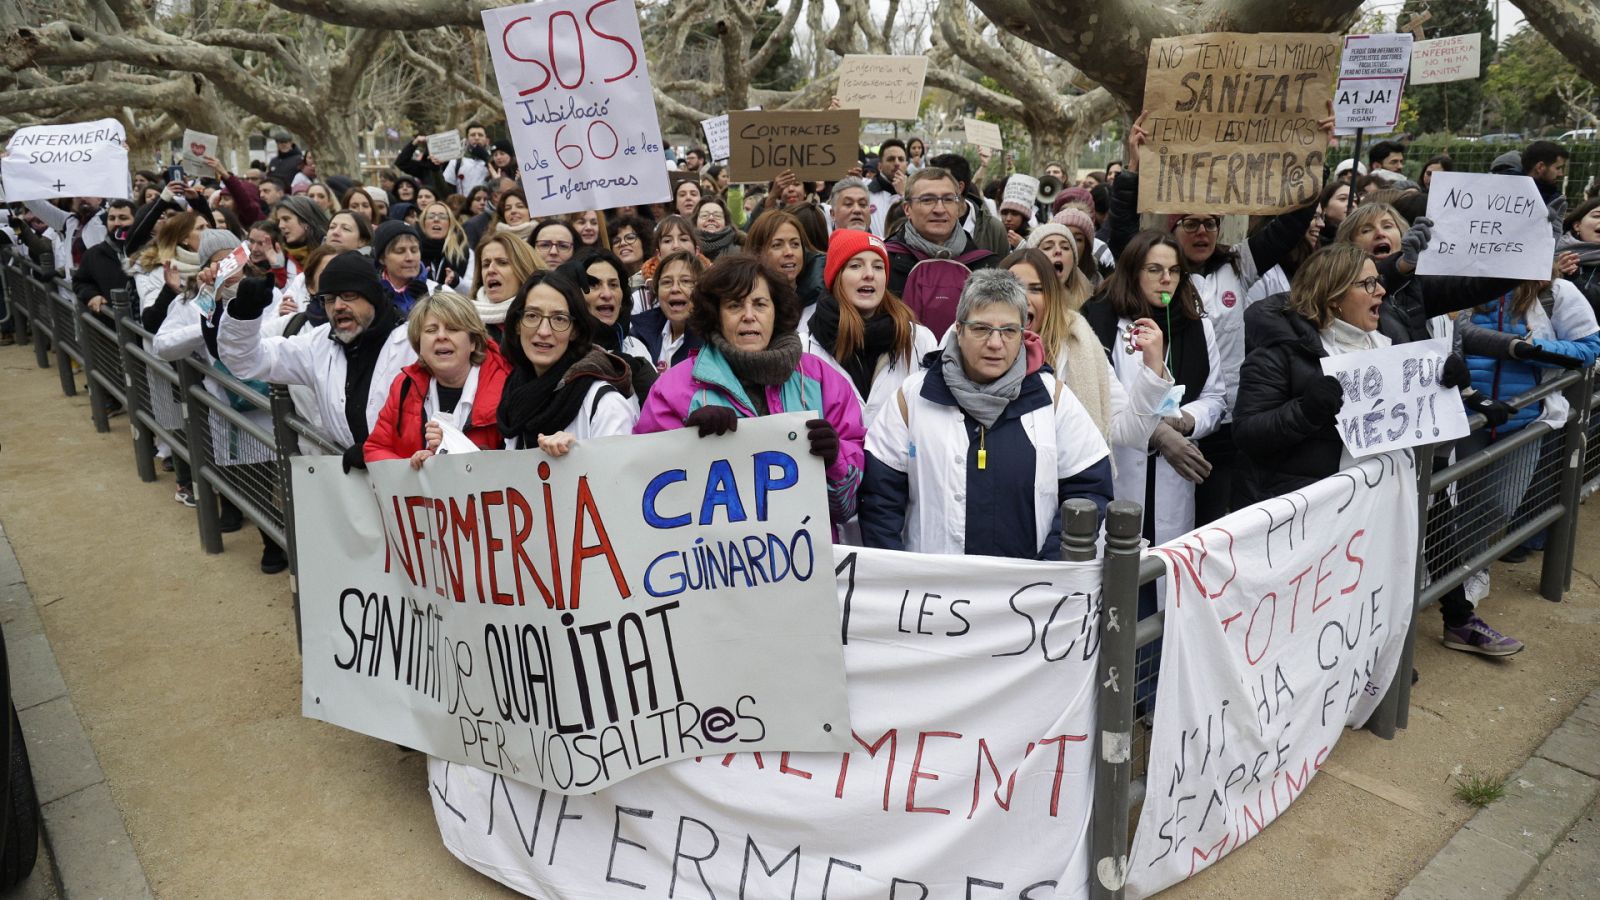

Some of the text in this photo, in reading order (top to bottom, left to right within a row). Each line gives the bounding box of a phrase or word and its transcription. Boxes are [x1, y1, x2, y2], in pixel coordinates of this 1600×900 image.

[1431, 37, 1464, 48] SENSE
[1157, 44, 1184, 69] NO
[1257, 44, 1278, 68] LA
[1421, 65, 1462, 79] SANITAT
[1338, 90, 1392, 105] A1 JA!
[515, 96, 610, 126] Jubilació
[11, 128, 122, 146] ENFERMERIA
[740, 123, 841, 140] CONTRACTES
[29, 149, 93, 165] SOMOS
[524, 120, 659, 172] als 60 de les
[537, 174, 639, 200] Infermeres
[1443, 187, 1536, 218] NO VOLEM
[1469, 220, 1503, 235] FER
[1438, 241, 1524, 255] DE METGES
[1336, 365, 1384, 403] NO
[642, 450, 799, 529] CAP
[897, 589, 971, 637] LES
[1318, 584, 1383, 671] QUE
[459, 695, 766, 790] PER VOSALTR@S
